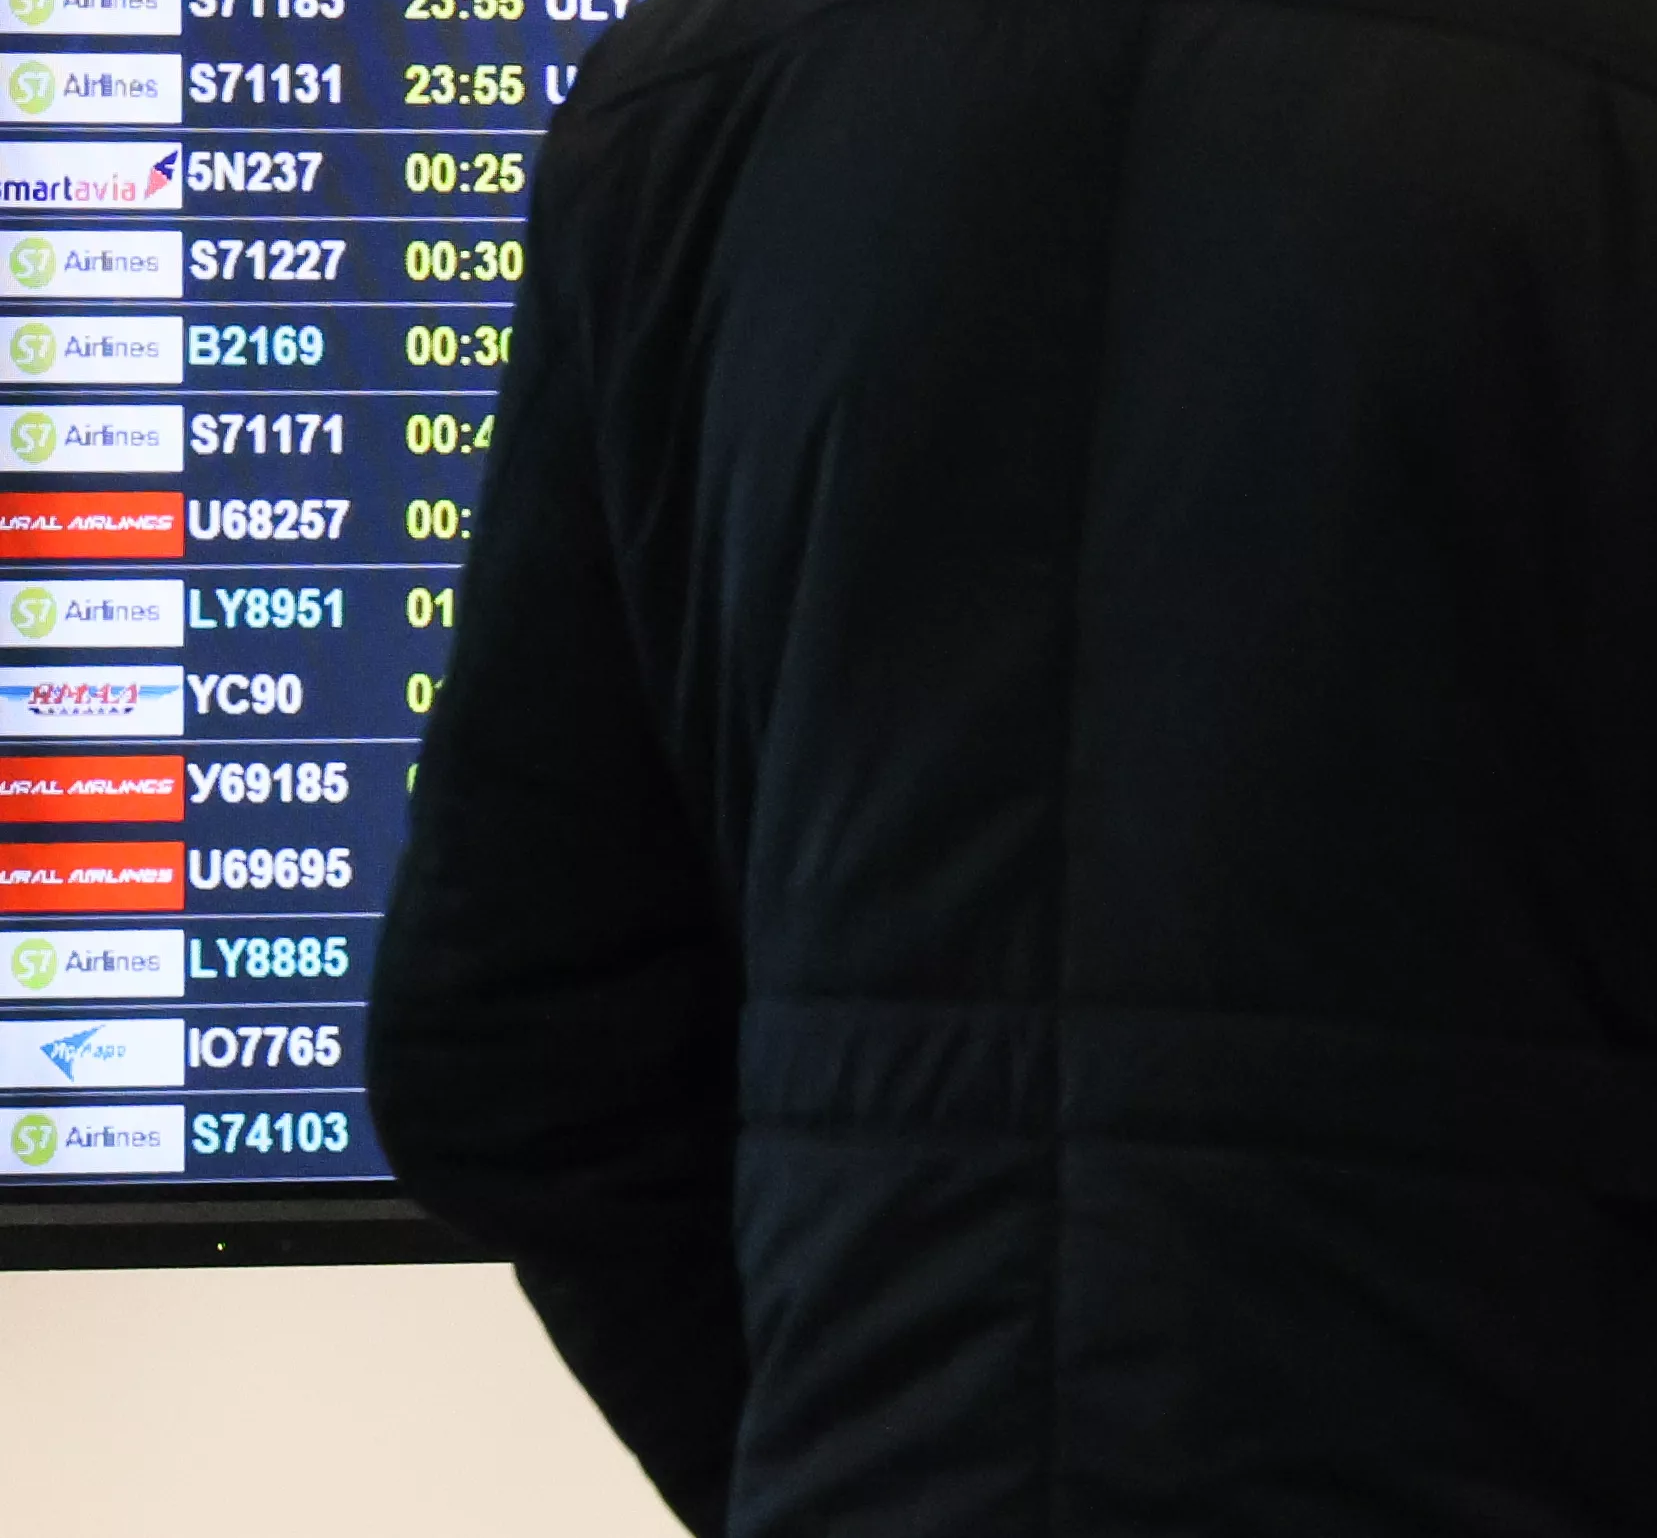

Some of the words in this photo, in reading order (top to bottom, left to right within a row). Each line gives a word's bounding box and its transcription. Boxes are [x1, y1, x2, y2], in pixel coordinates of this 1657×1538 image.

[187, 152, 322, 191] 5N237
[406, 153, 525, 192] 00:25
[190, 240, 346, 280] S71227
[406, 241, 523, 281] 00:30
[189, 326, 323, 365] B2169
[189, 500, 350, 540] U68257
[190, 588, 342, 628] LY8951
[187, 674, 302, 714] YC90
[189, 848, 352, 889] U69695
[190, 937, 348, 978] LY8885
[189, 1026, 341, 1067] IO7765
[193, 1112, 348, 1153] S74103
